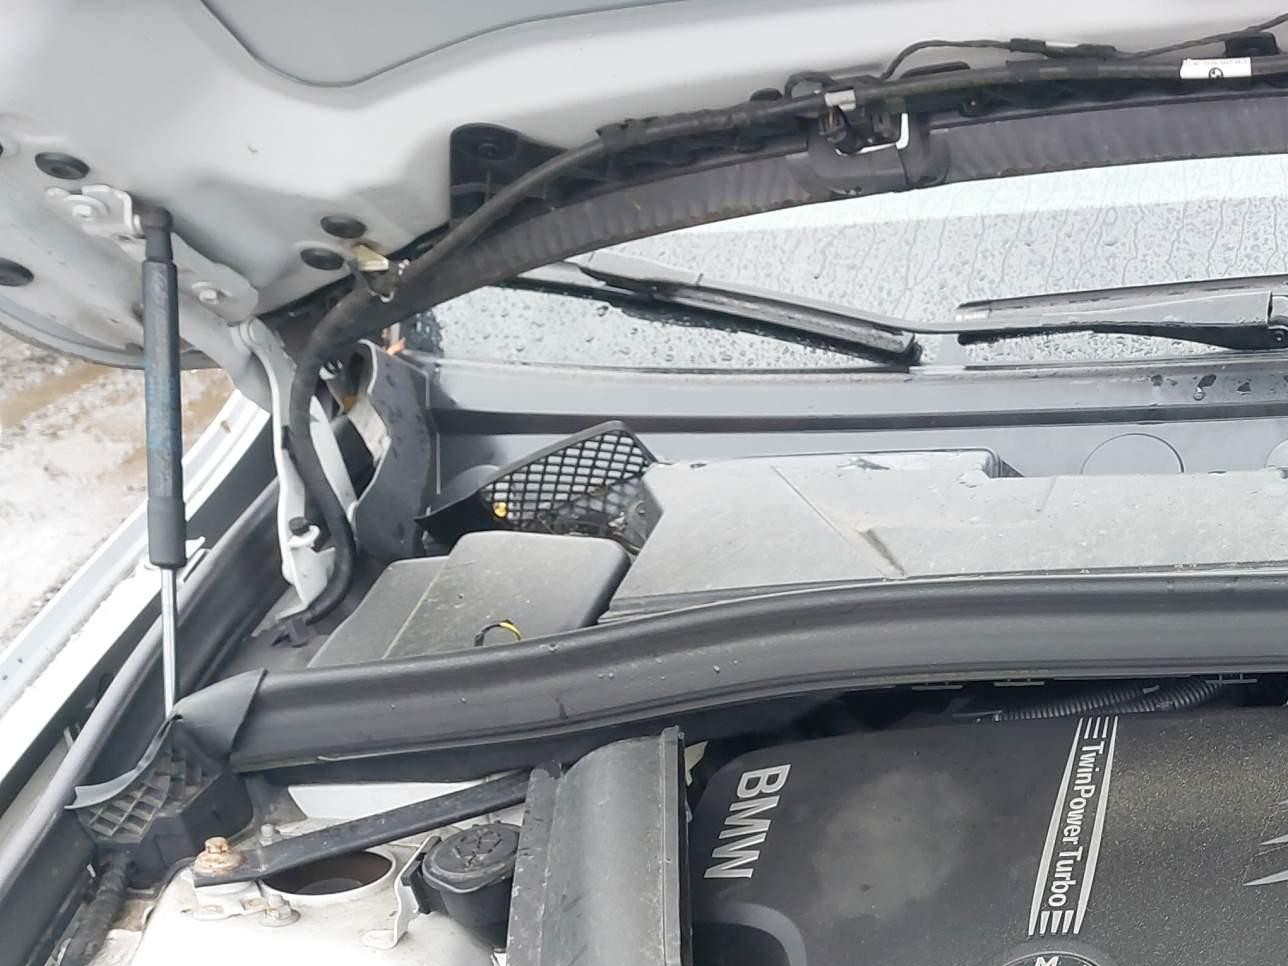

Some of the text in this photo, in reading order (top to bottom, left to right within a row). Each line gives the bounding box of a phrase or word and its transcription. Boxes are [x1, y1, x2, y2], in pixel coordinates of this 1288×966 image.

[704, 764, 791, 878] BMW
[1048, 741, 1105, 907] TwinPower Turbo
